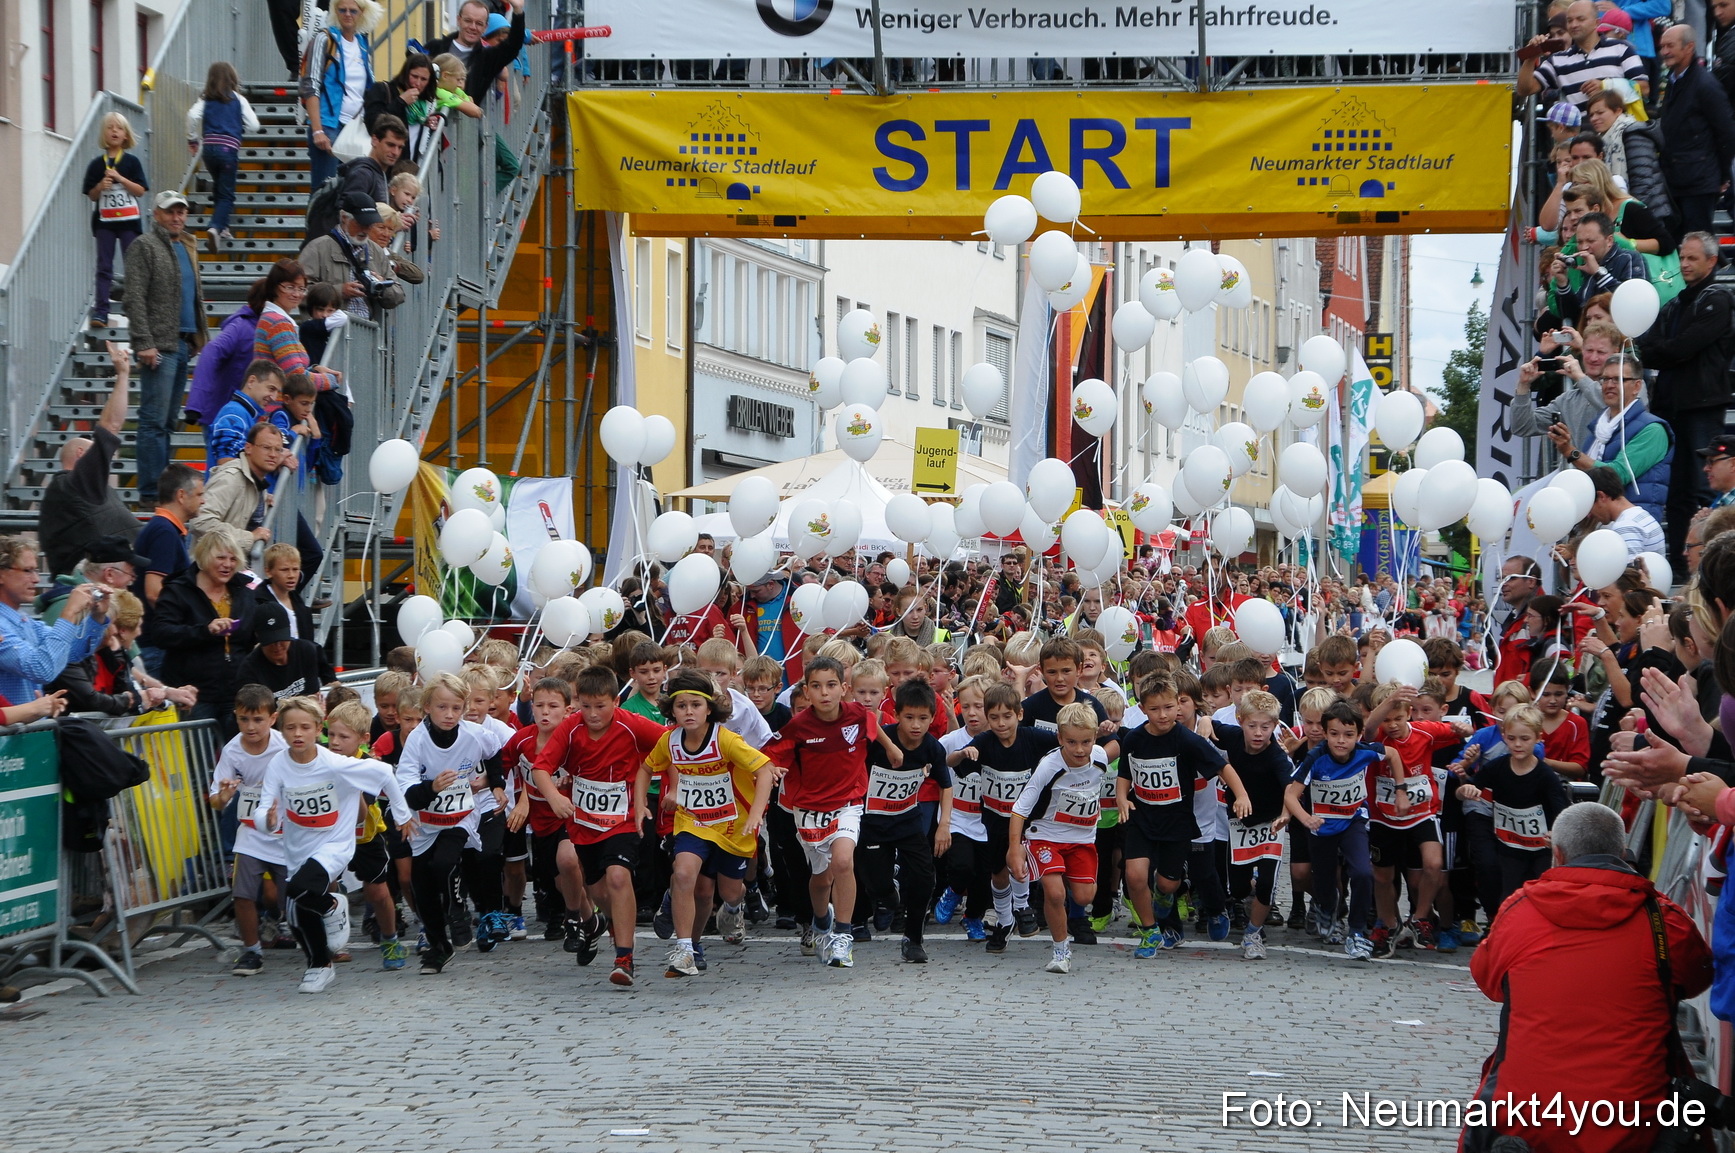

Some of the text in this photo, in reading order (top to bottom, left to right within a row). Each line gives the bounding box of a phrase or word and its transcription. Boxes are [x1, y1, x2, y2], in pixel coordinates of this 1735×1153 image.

[855, 3, 1339, 33] Weniger Verbrauch. Mehr Fahrfreude.
[555, 31, 577, 39] BKK
[872, 116, 1192, 193] START
[1250, 151, 1454, 173] Neumarkter Stadtlauf
[619, 154, 818, 178] Neumarkter Stadtlauf
[736, 395, 794, 437] BRILLEN WEBER
[916, 444, 957, 458] Jugend-
[926, 457, 946, 468] lauf
[698, 761, 726, 775] BÖGL
[872, 770, 891, 780] PARTL
[1140, 761, 1168, 769] Neumarkt
[681, 787, 728, 808] 7283
[875, 780, 919, 800] 7238
[986, 777, 1026, 800] 7127
[1141, 790, 1165, 801] Robin
[1317, 785, 1362, 805] 7242
[1382, 786, 1426, 806] 728
[576, 789, 622, 812] 7097
[1498, 812, 1540, 836] 7113
